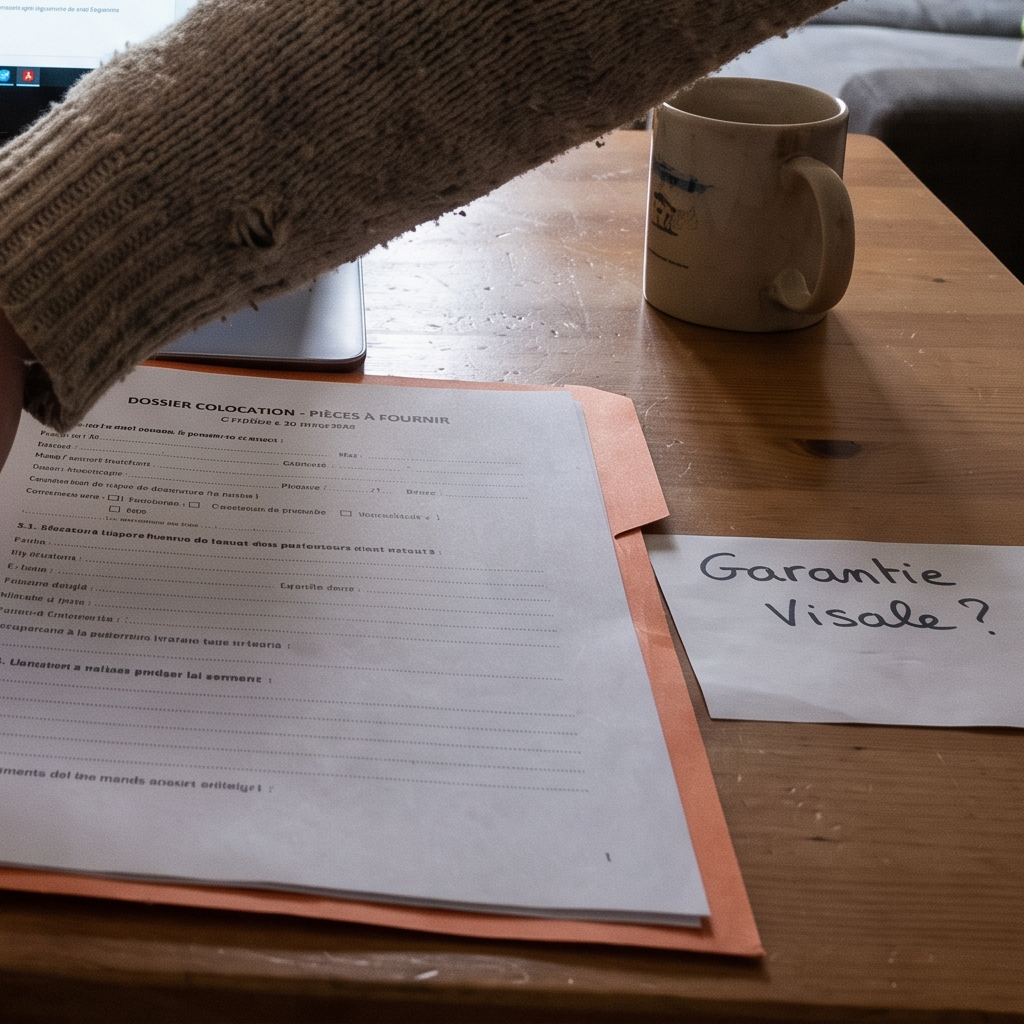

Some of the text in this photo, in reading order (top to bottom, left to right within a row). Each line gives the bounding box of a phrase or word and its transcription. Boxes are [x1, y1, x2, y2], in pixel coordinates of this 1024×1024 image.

[127, 396, 192, 410] DOSSIER
[195, 403, 295, 417] COLOCATION
[309, 409, 360, 420] PIÈCES
[364, 410, 376, 421] À
[379, 414, 451, 425] FOURNIR
[699, 552, 957, 586] Garantie
